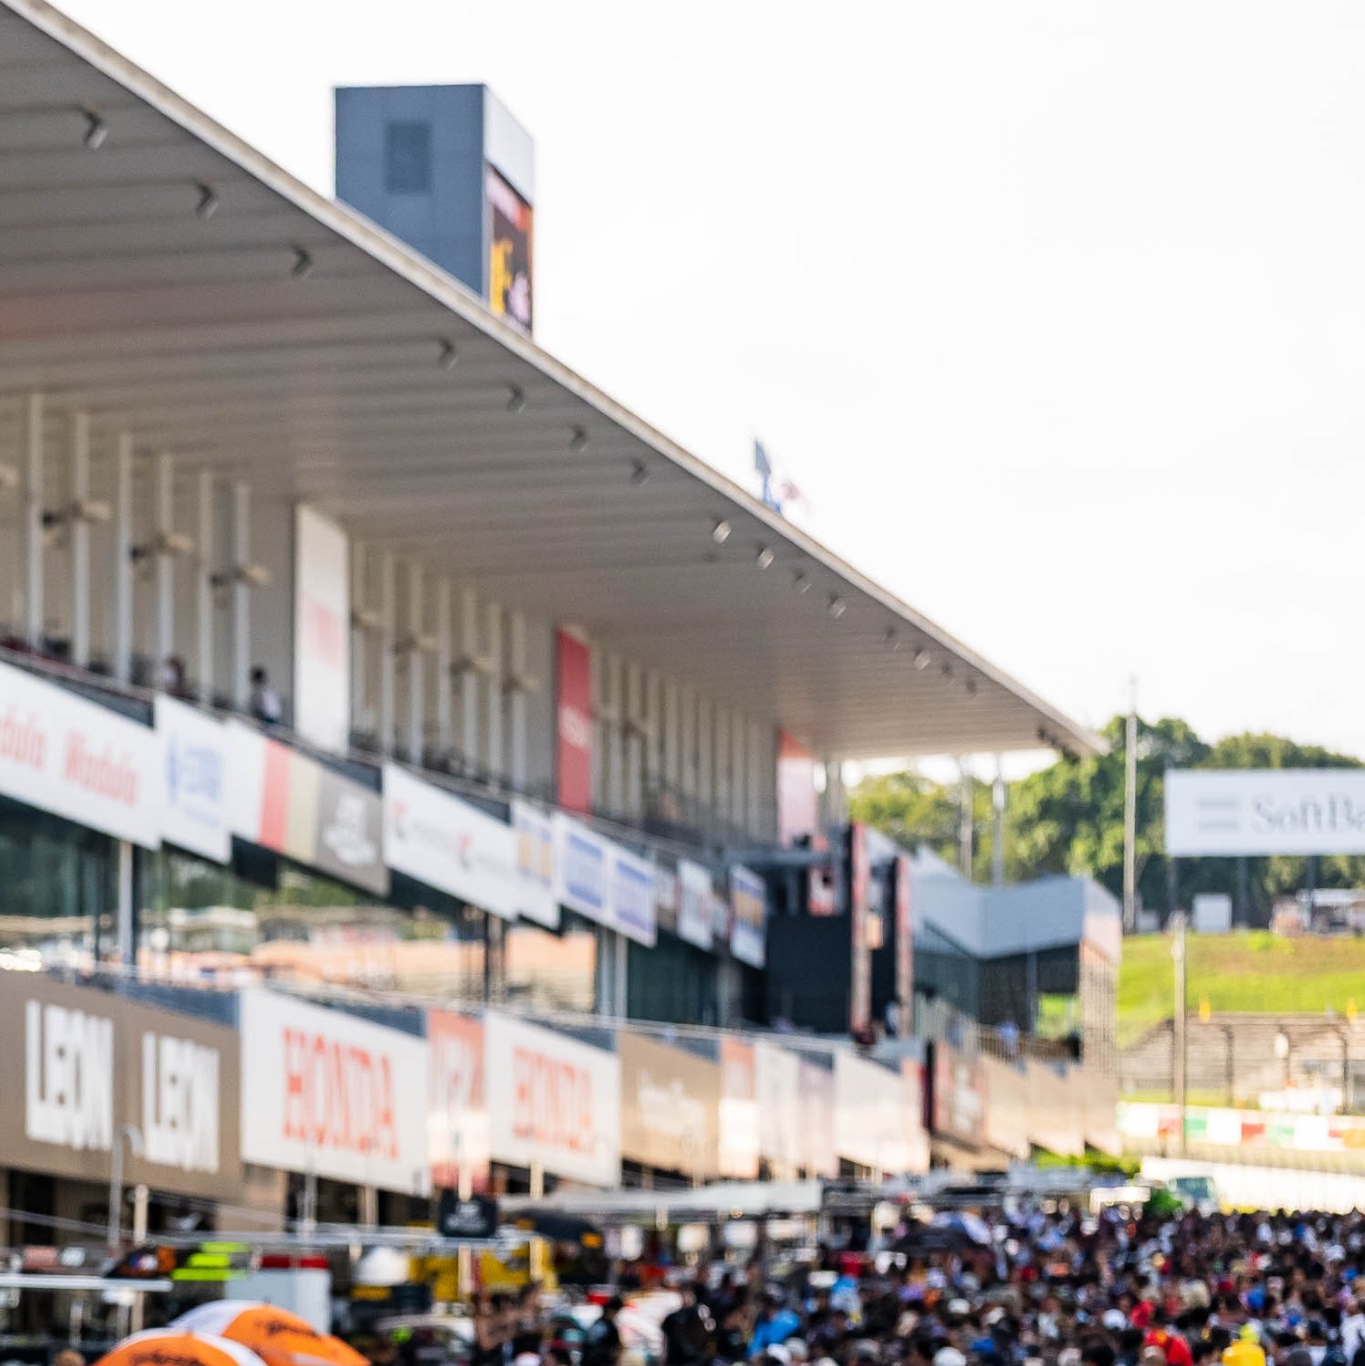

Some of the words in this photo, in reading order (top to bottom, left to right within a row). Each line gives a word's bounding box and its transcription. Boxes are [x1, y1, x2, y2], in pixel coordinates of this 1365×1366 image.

[25, 1000, 114, 1151] LEON
[143, 1031, 220, 1173] LEON
[283, 1027, 399, 1161] HONDA
